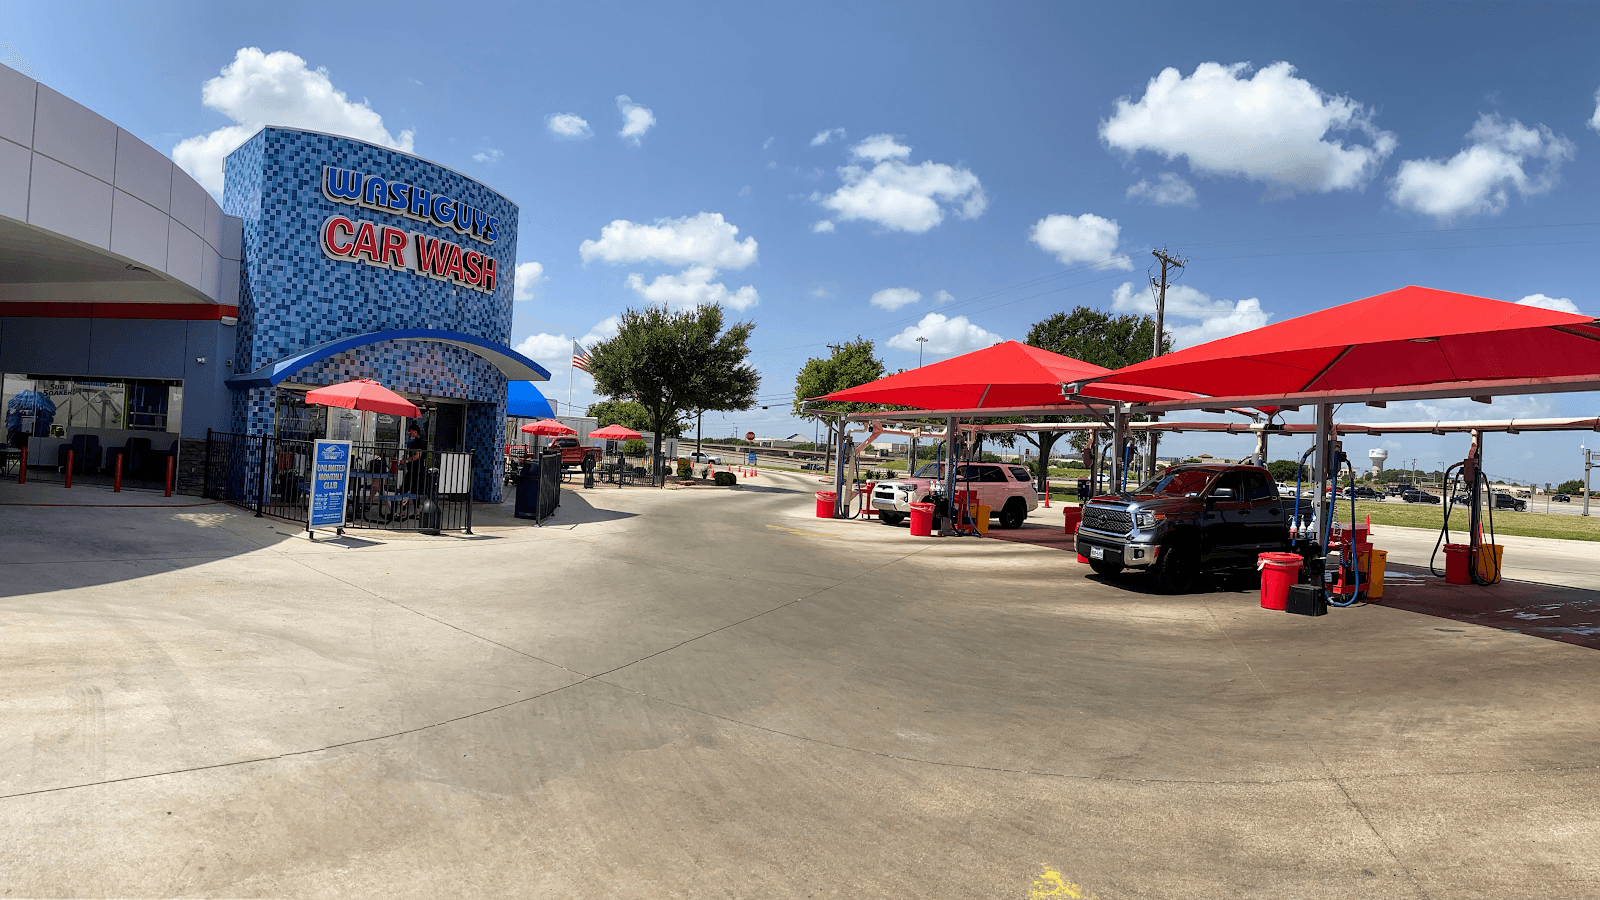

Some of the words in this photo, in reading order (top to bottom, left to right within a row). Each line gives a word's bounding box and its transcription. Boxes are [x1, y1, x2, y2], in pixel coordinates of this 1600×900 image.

[327, 166, 499, 242] WASHGUYS
[325, 217, 407, 267] CAR
[417, 234, 498, 291] WASH
[317, 464, 345, 472] UNLIMITED
